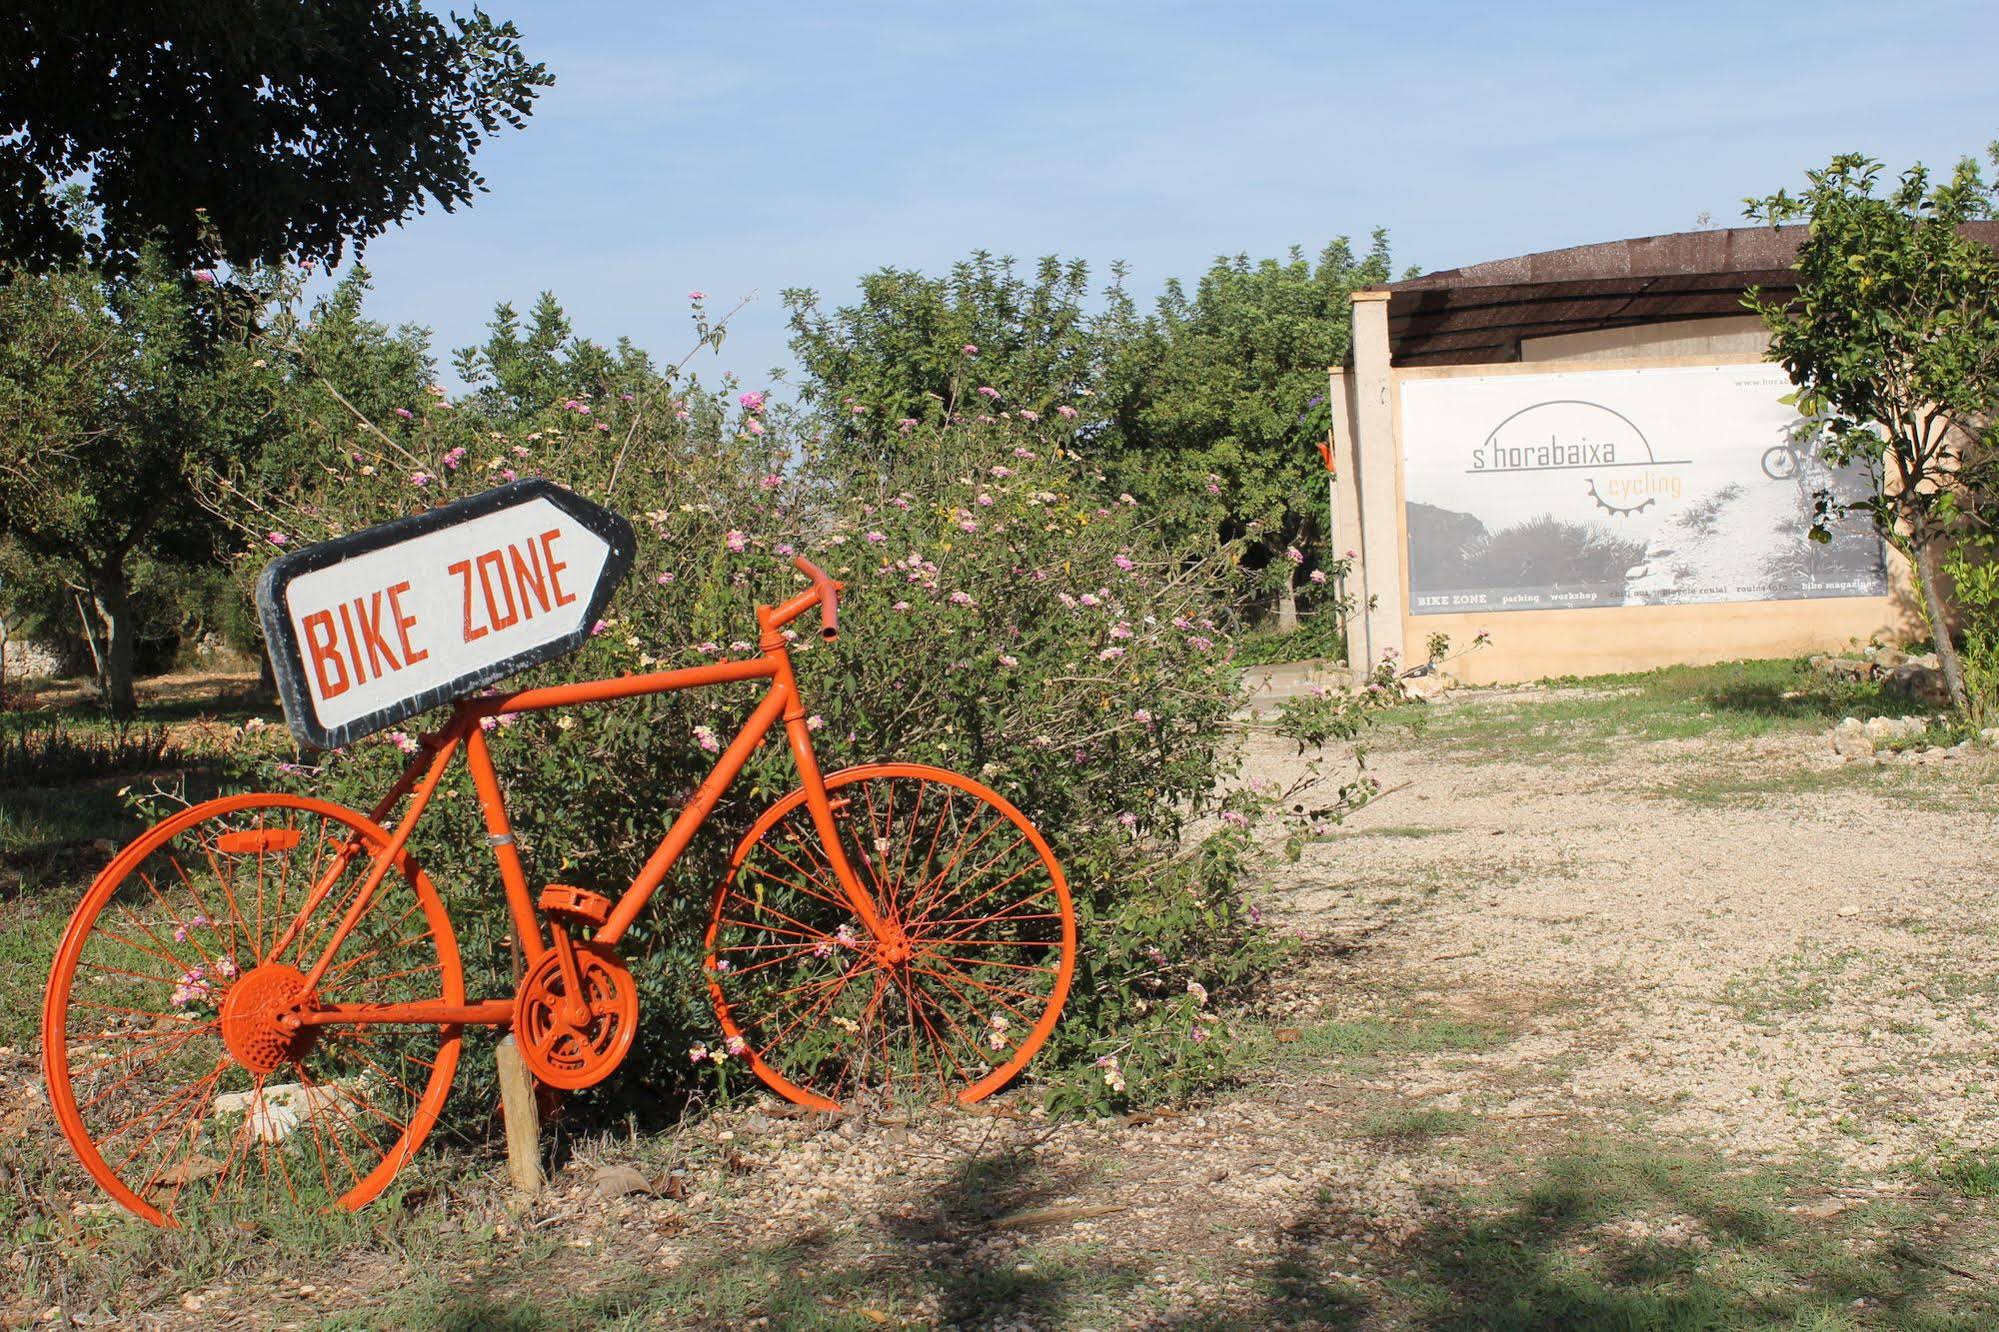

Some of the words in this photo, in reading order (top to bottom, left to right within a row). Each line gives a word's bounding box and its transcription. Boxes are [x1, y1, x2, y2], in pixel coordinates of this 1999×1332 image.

[1608, 471, 1682, 499] cycling
[1736, 583, 1765, 593] routes
[1801, 581, 1823, 592] bike
[1417, 595, 1449, 607] BIKE
[1452, 594, 1487, 605] ZONE
[1502, 593, 1540, 605] parking
[1550, 591, 1598, 602] workshop
[301, 580, 429, 701] BIKE
[447, 528, 576, 644] ZONE
